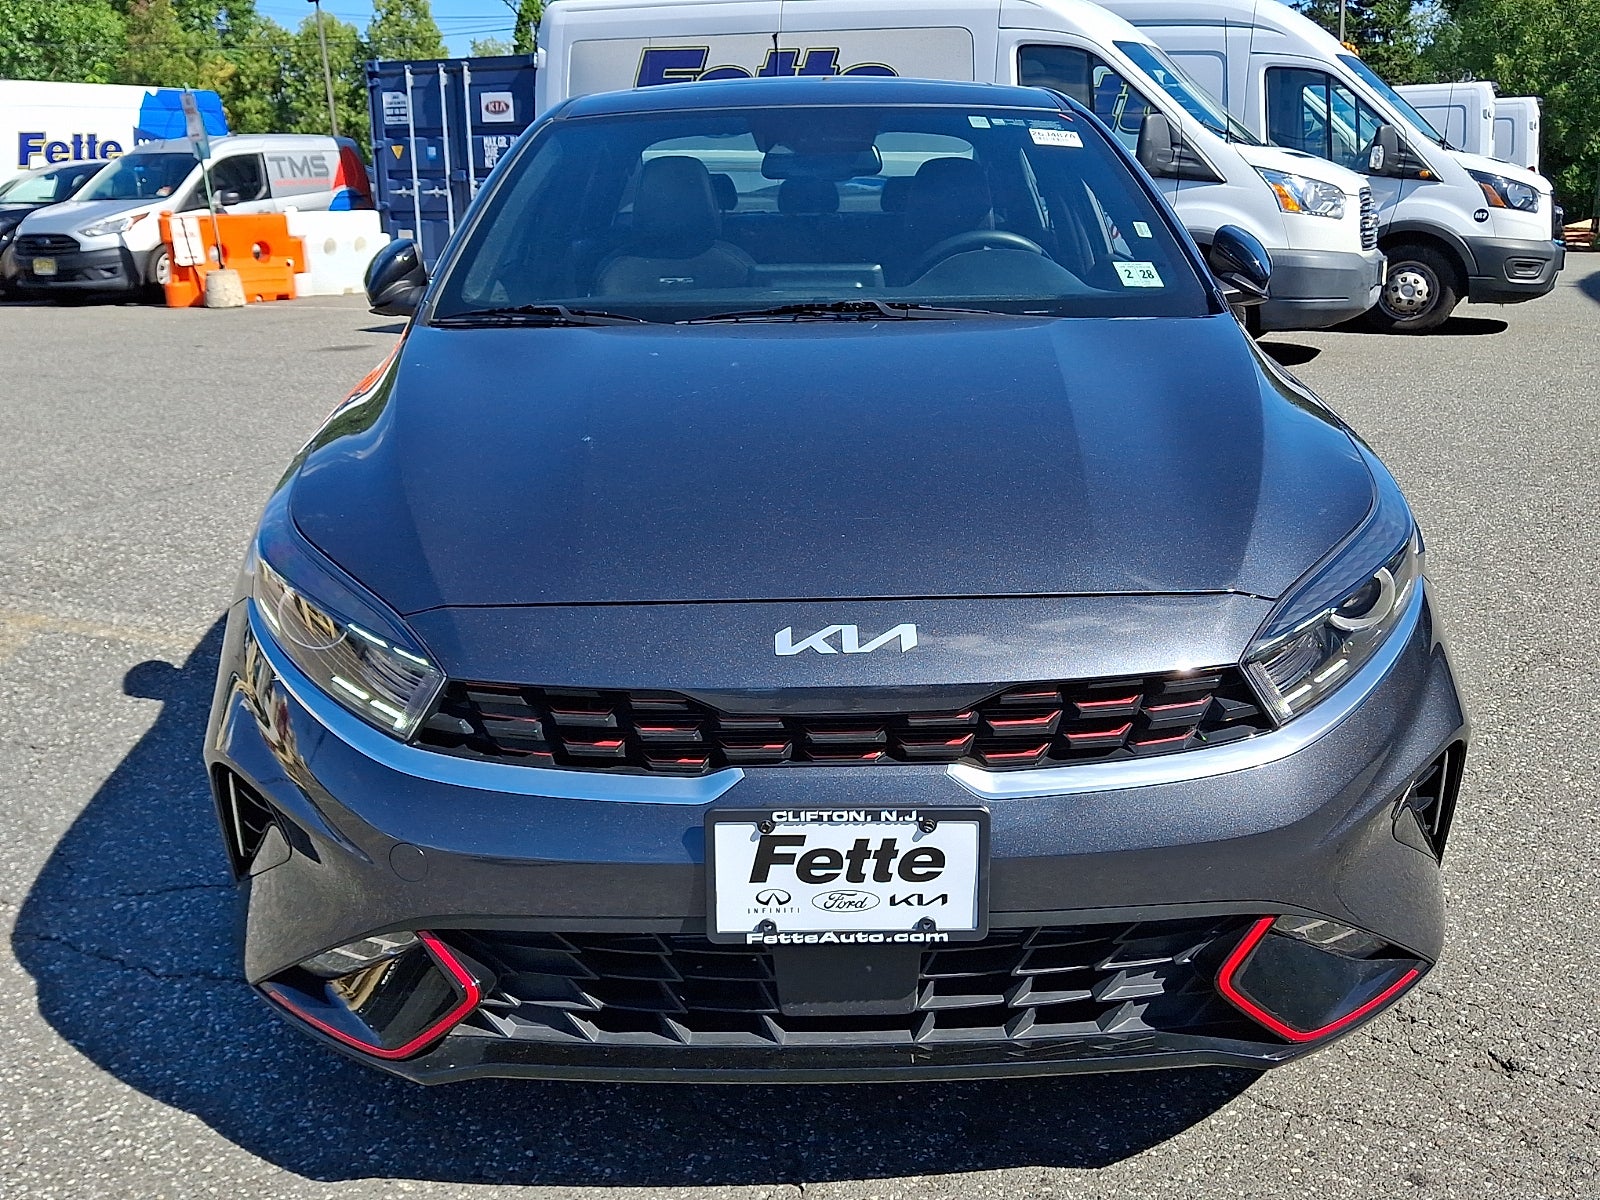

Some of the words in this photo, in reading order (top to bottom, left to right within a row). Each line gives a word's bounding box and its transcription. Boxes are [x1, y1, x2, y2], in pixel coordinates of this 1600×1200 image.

[488, 102, 507, 112] KIA
[18, 131, 124, 170] Fette
[267, 155, 329, 178] TMS
[1124, 269, 1134, 279] 2
[1139, 269, 1155, 279] 28
[772, 810, 872, 822] CLIFTON,
[880, 811, 924, 822] N.J.
[749, 834, 946, 885] Fette
[823, 892, 869, 910] Ford
[746, 931, 949, 945] FetteAuto.com
